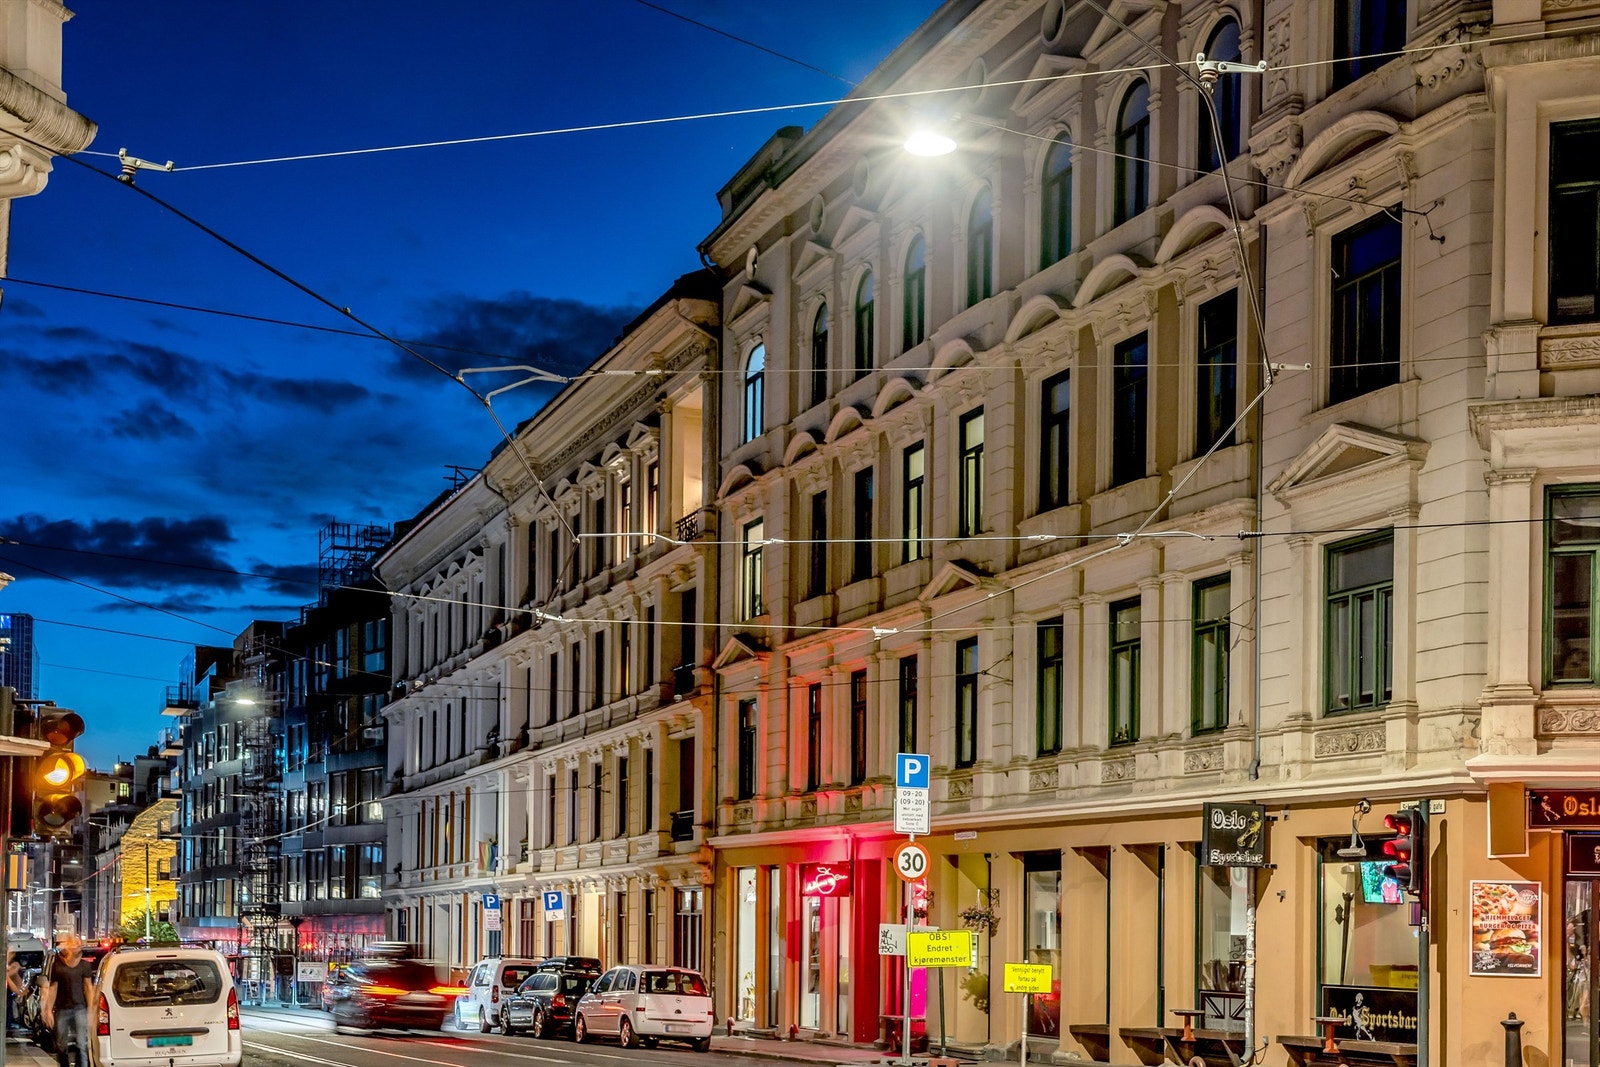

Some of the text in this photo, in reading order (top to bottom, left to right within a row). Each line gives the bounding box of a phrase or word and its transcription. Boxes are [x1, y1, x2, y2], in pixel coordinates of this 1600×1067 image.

[904, 758, 922, 784] P
[1564, 795, 1600, 816] Osl
[1211, 808, 1247, 829] Oslo
[901, 852, 924, 872] 30
[1210, 849, 1264, 865] Sportsbar
[486, 896, 496, 908] P
[548, 893, 559, 909] P
[929, 933, 951, 941] OBS!
[914, 956, 967, 964] kjøremønster
[1361, 1006, 1417, 1030] Sportsbar
